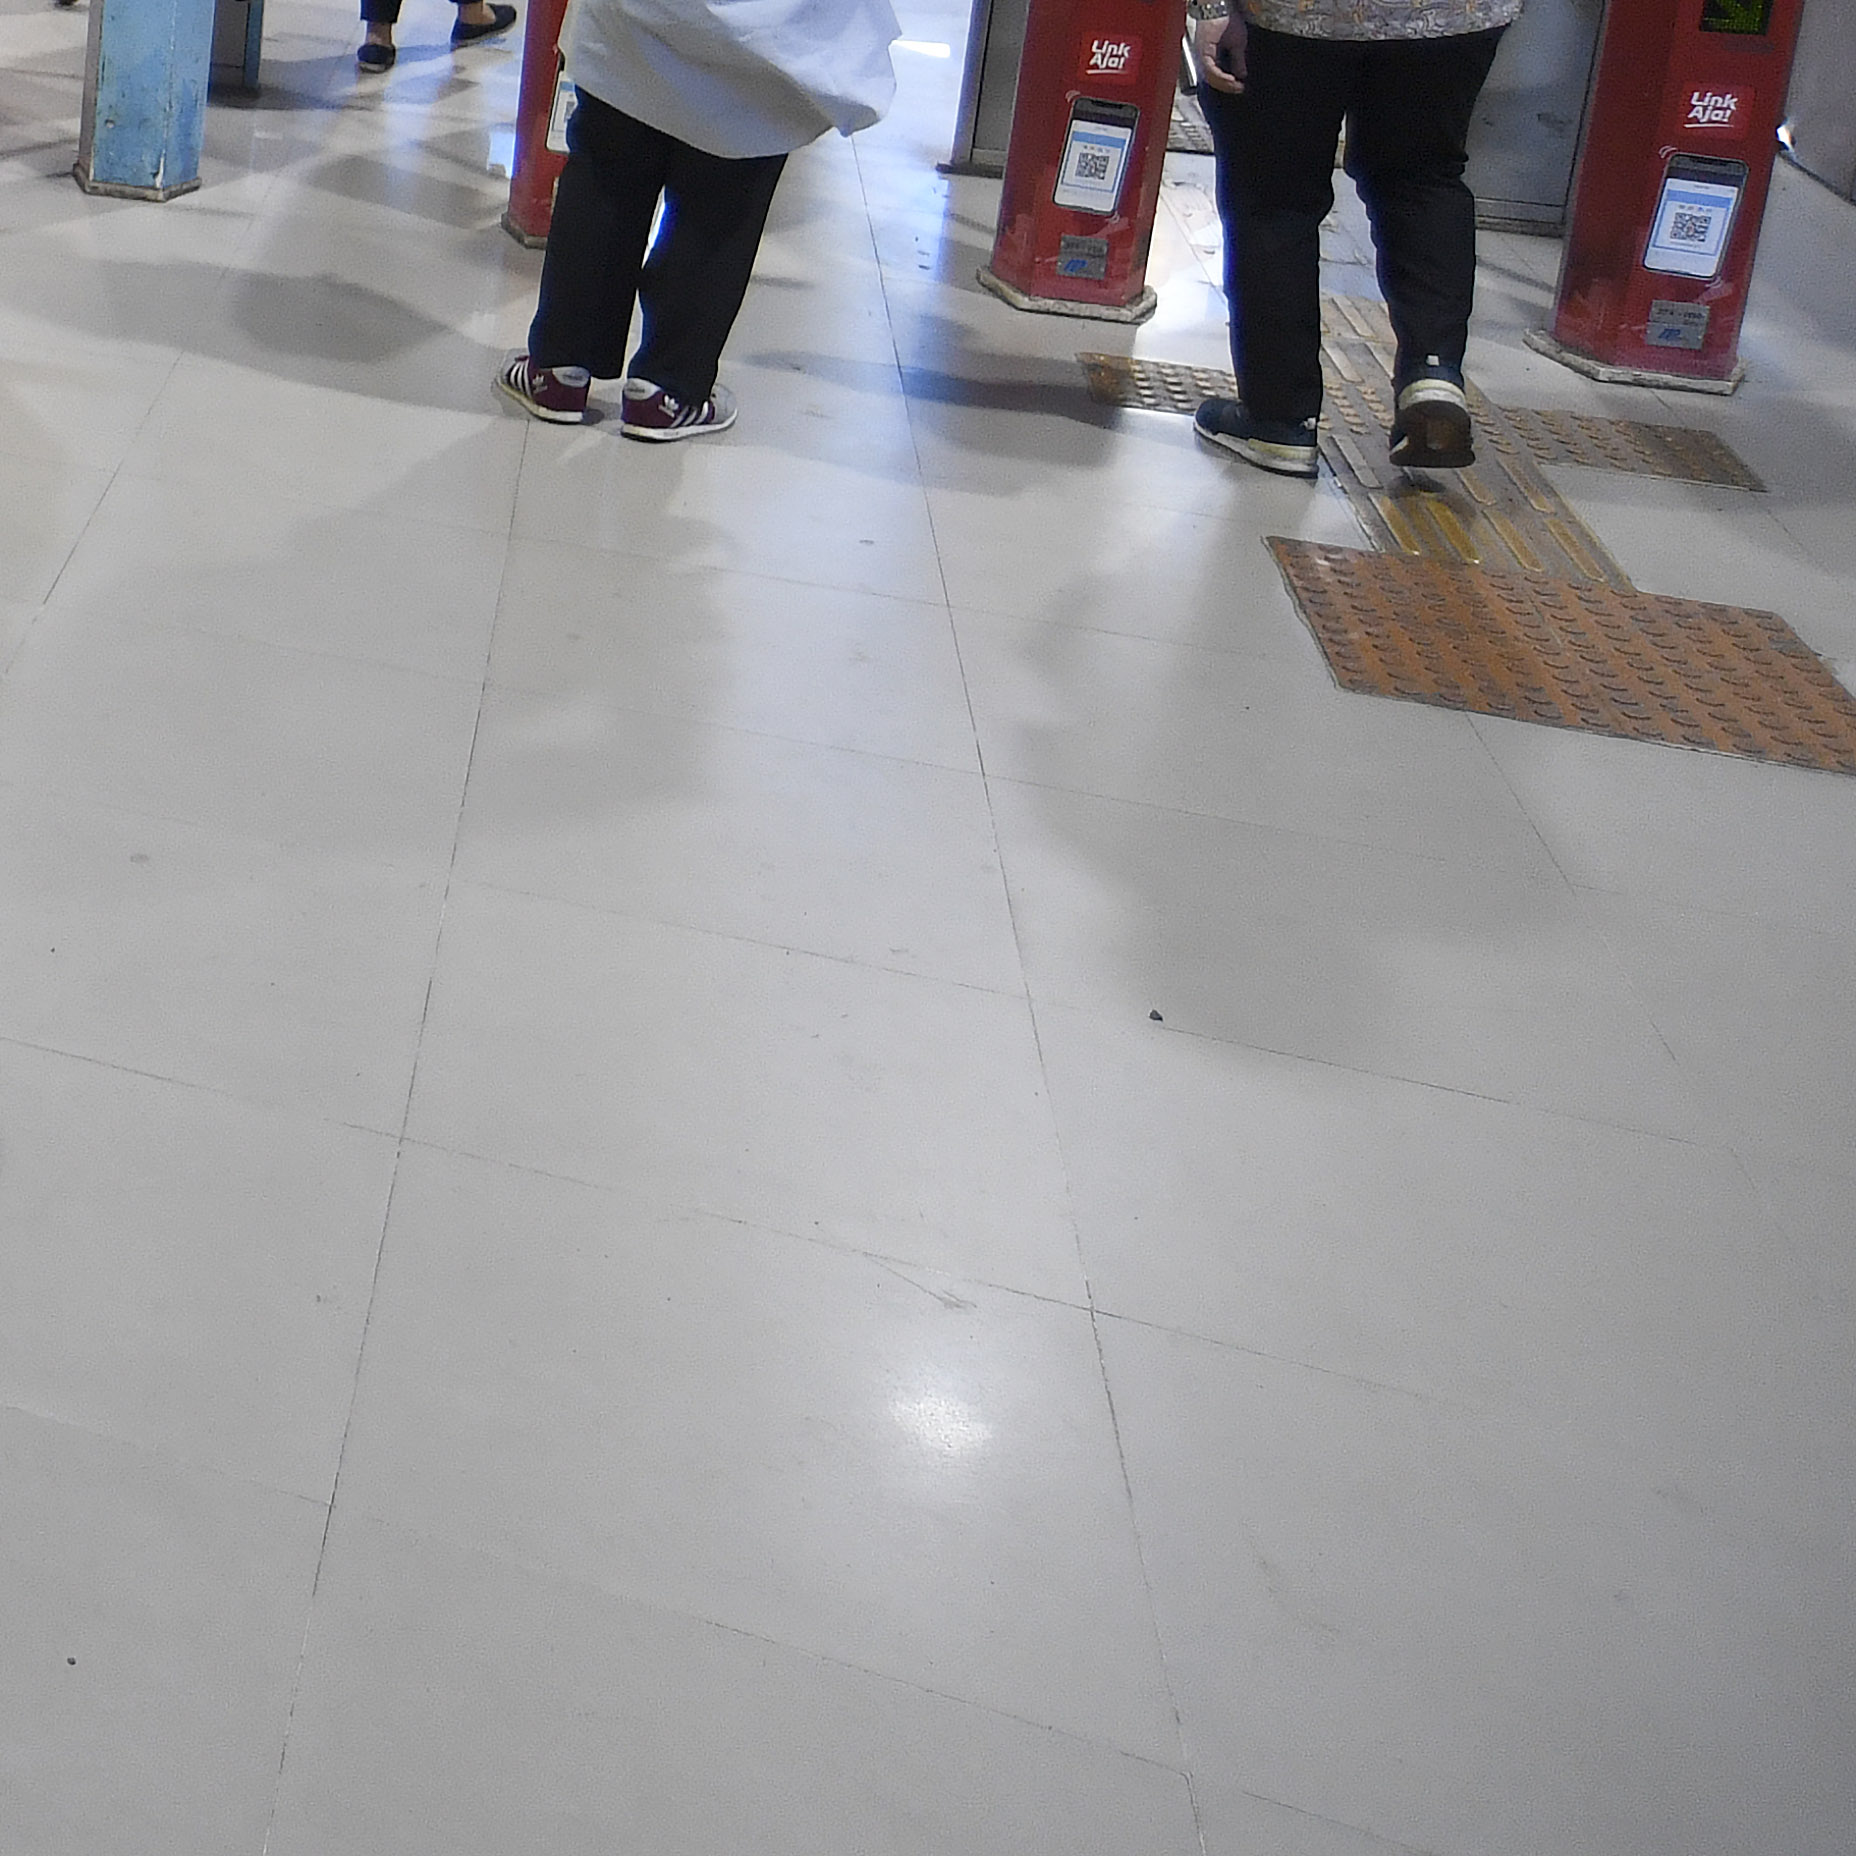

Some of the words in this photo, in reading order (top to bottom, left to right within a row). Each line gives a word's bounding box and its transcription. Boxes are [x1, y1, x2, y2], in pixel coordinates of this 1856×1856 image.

[1091, 39, 1132, 58] Link
[1089, 52, 1126, 70] Aja!
[1691, 91, 1738, 111] Link
[1688, 106, 1732, 123] Aja!
